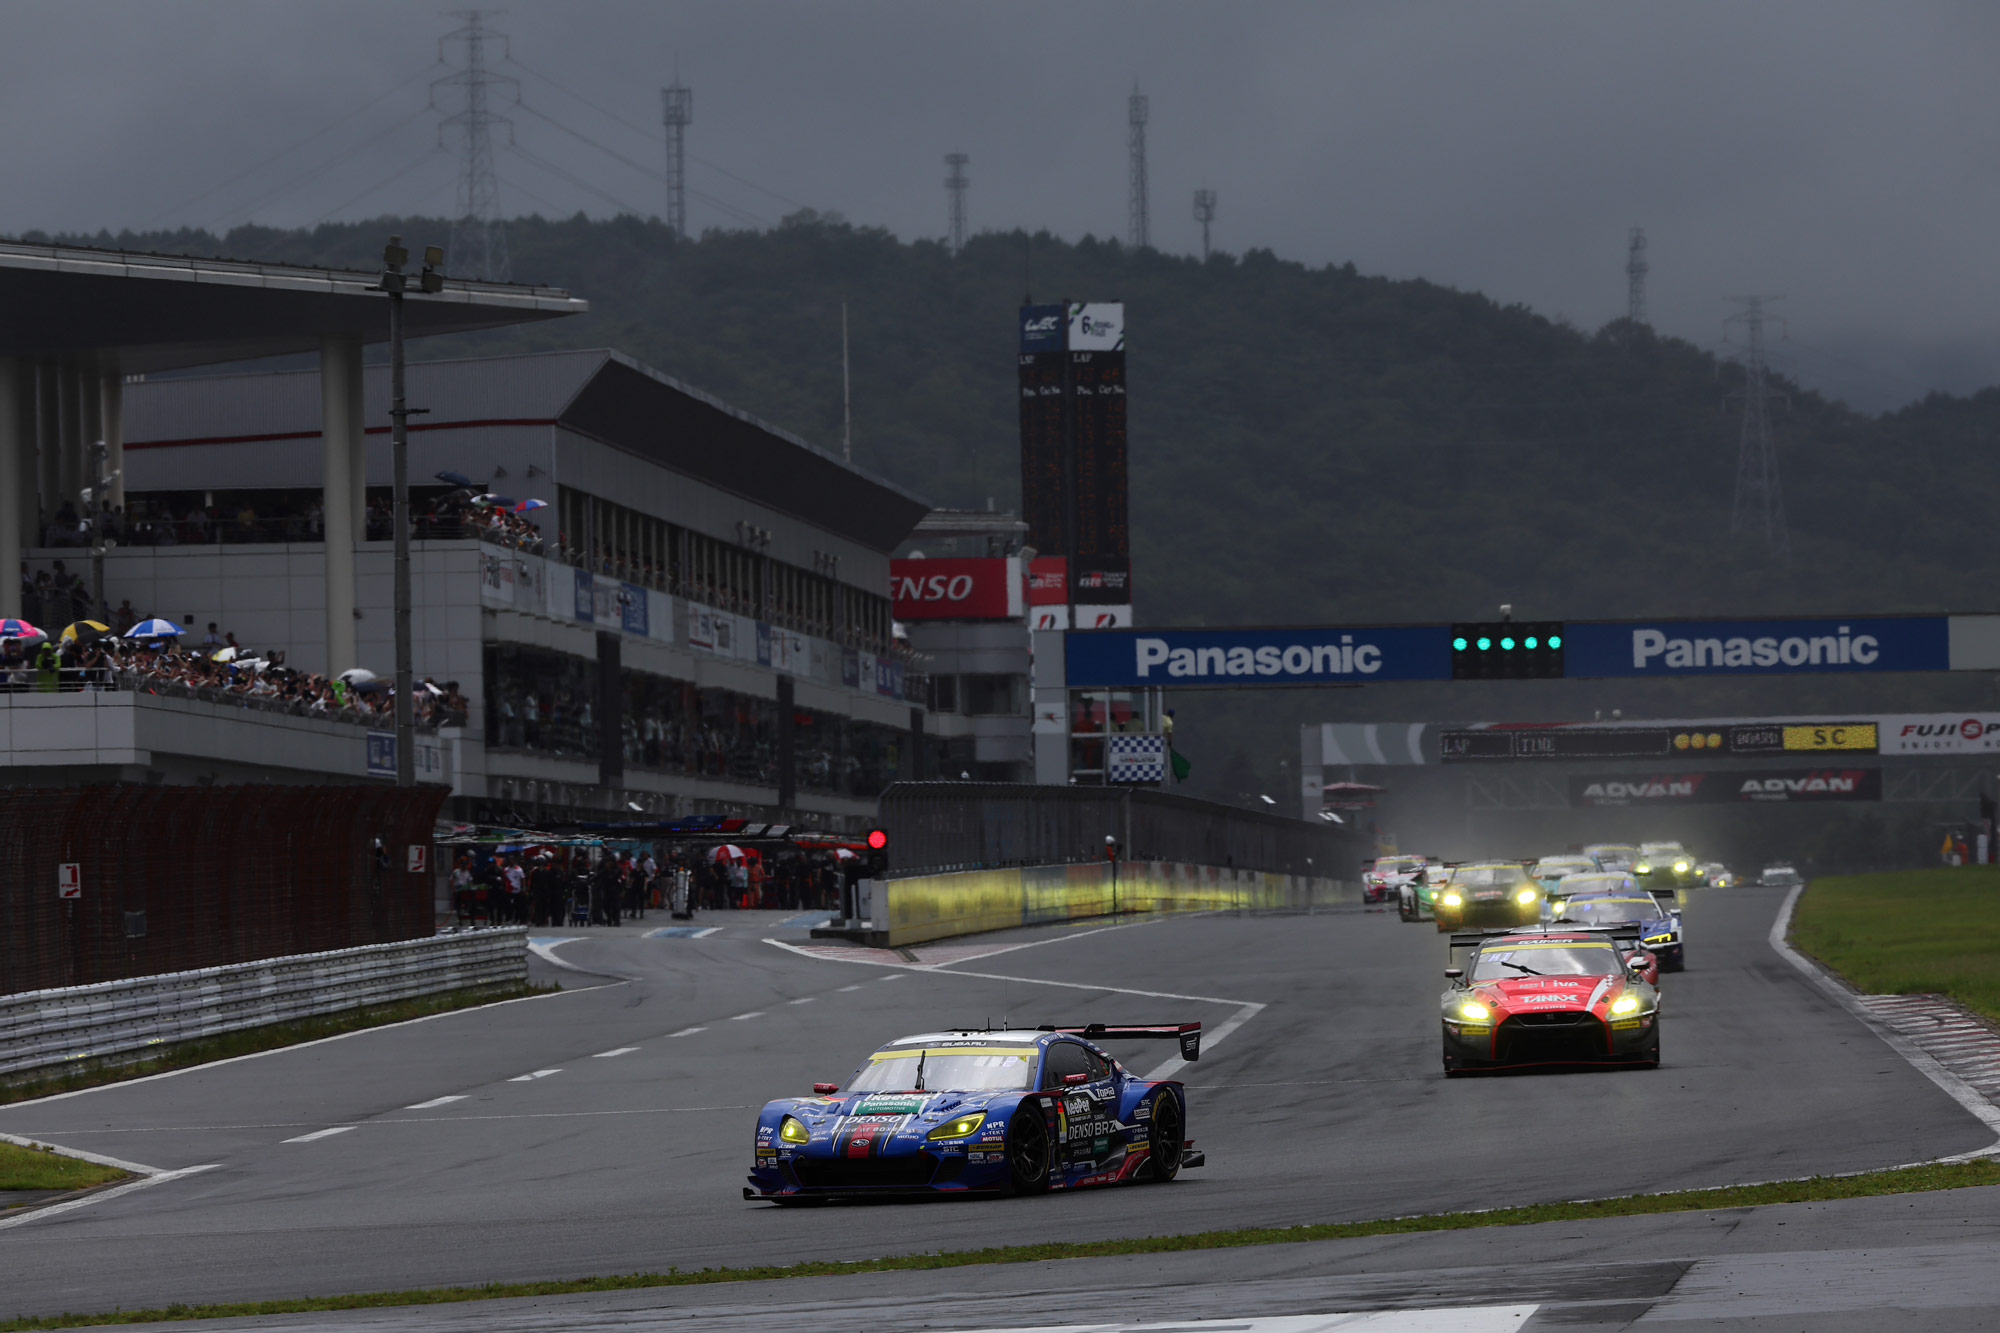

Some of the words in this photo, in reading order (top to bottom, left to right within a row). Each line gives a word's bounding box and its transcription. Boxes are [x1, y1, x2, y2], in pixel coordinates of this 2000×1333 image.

[1632, 626, 1879, 668] Panasonic
[1136, 635, 1382, 677] Panasonic
[1900, 723, 1957, 737] FUJI
[1582, 781, 1693, 798] ADVAN
[1740, 777, 1853, 793] ADVAN
[1521, 994, 1579, 1003] TANAX
[1064, 1098, 1090, 1116] KeePer
[845, 1116, 902, 1124] DENSO
[987, 1120, 1005, 1129] NPR
[1068, 1122, 1094, 1140] DENSO
[1095, 1119, 1116, 1136] BRZ
